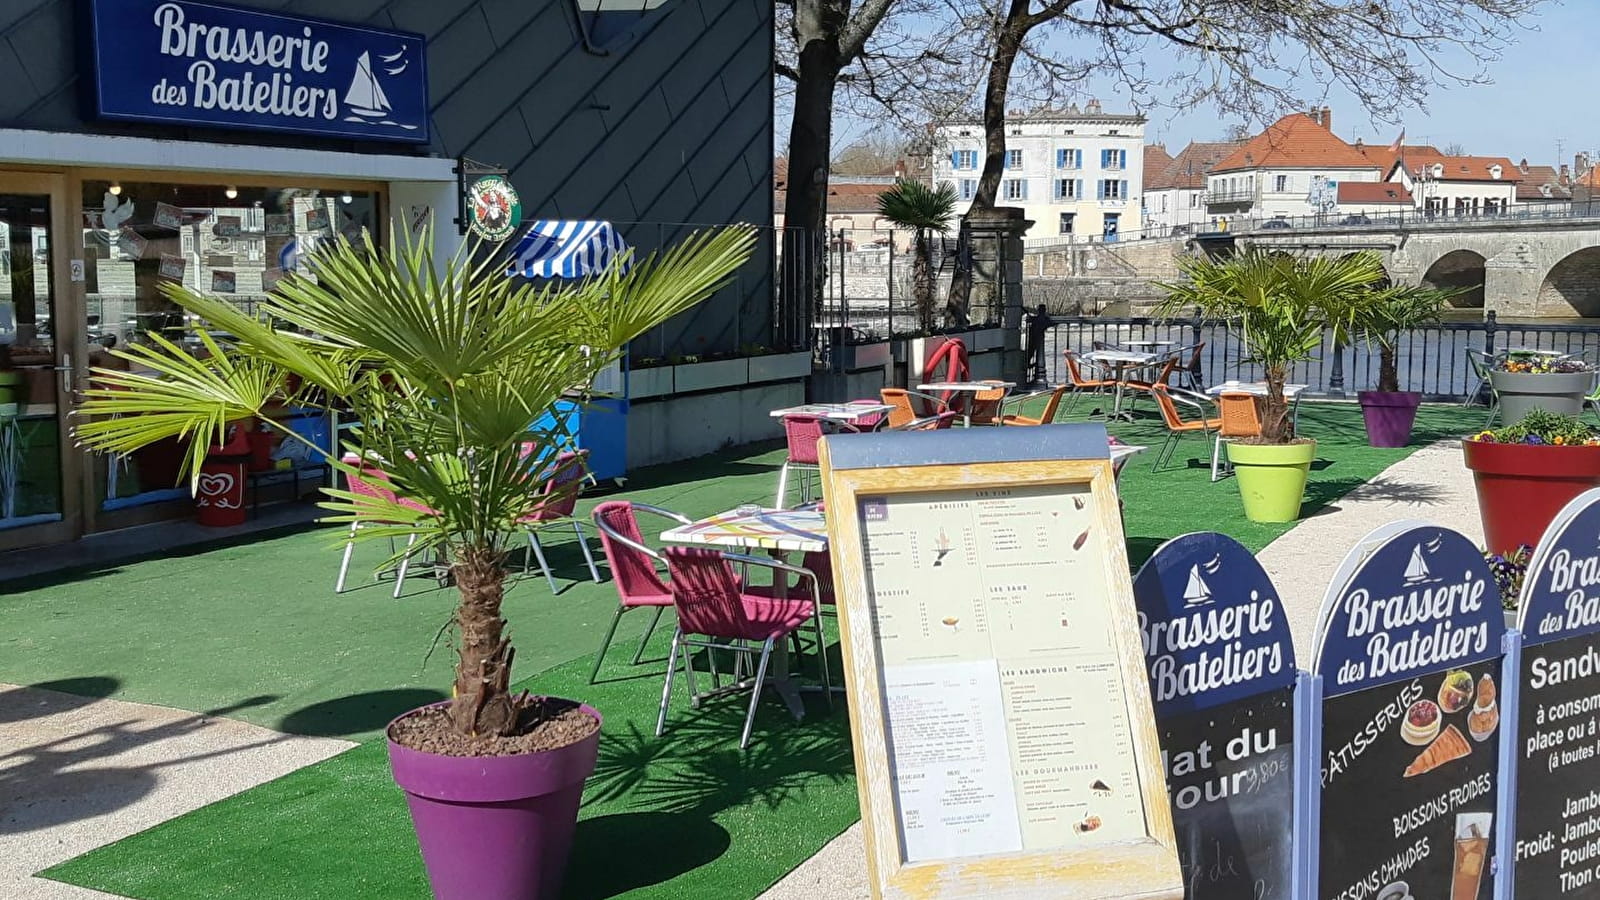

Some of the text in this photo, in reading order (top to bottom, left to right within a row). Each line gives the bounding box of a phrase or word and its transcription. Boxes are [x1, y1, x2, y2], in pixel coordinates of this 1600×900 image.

[154, 3, 329, 73] Brasserie
[152, 60, 338, 120] des Bateliers
[1549, 549, 1600, 593] Bra
[1344, 570, 1485, 637] Brasserie
[1539, 589, 1600, 635] des Ba
[1151, 641, 1282, 702] Bateliers
[1337, 620, 1488, 685] des Bateliers
[1162, 728, 1276, 780] lat du
[1320, 678, 1424, 790] PÂTISSERIES
[1527, 728, 1564, 759] place
[1567, 723, 1585, 741] ou
[1562, 744, 1594, 766] toutes
[1168, 769, 1247, 810] our
[1393, 772, 1491, 839] BOISSONS FROIDES
[1381, 836, 1430, 884] CHAUDES
[1516, 831, 1556, 862] Froid:
[1560, 868, 1592, 893] Thon
